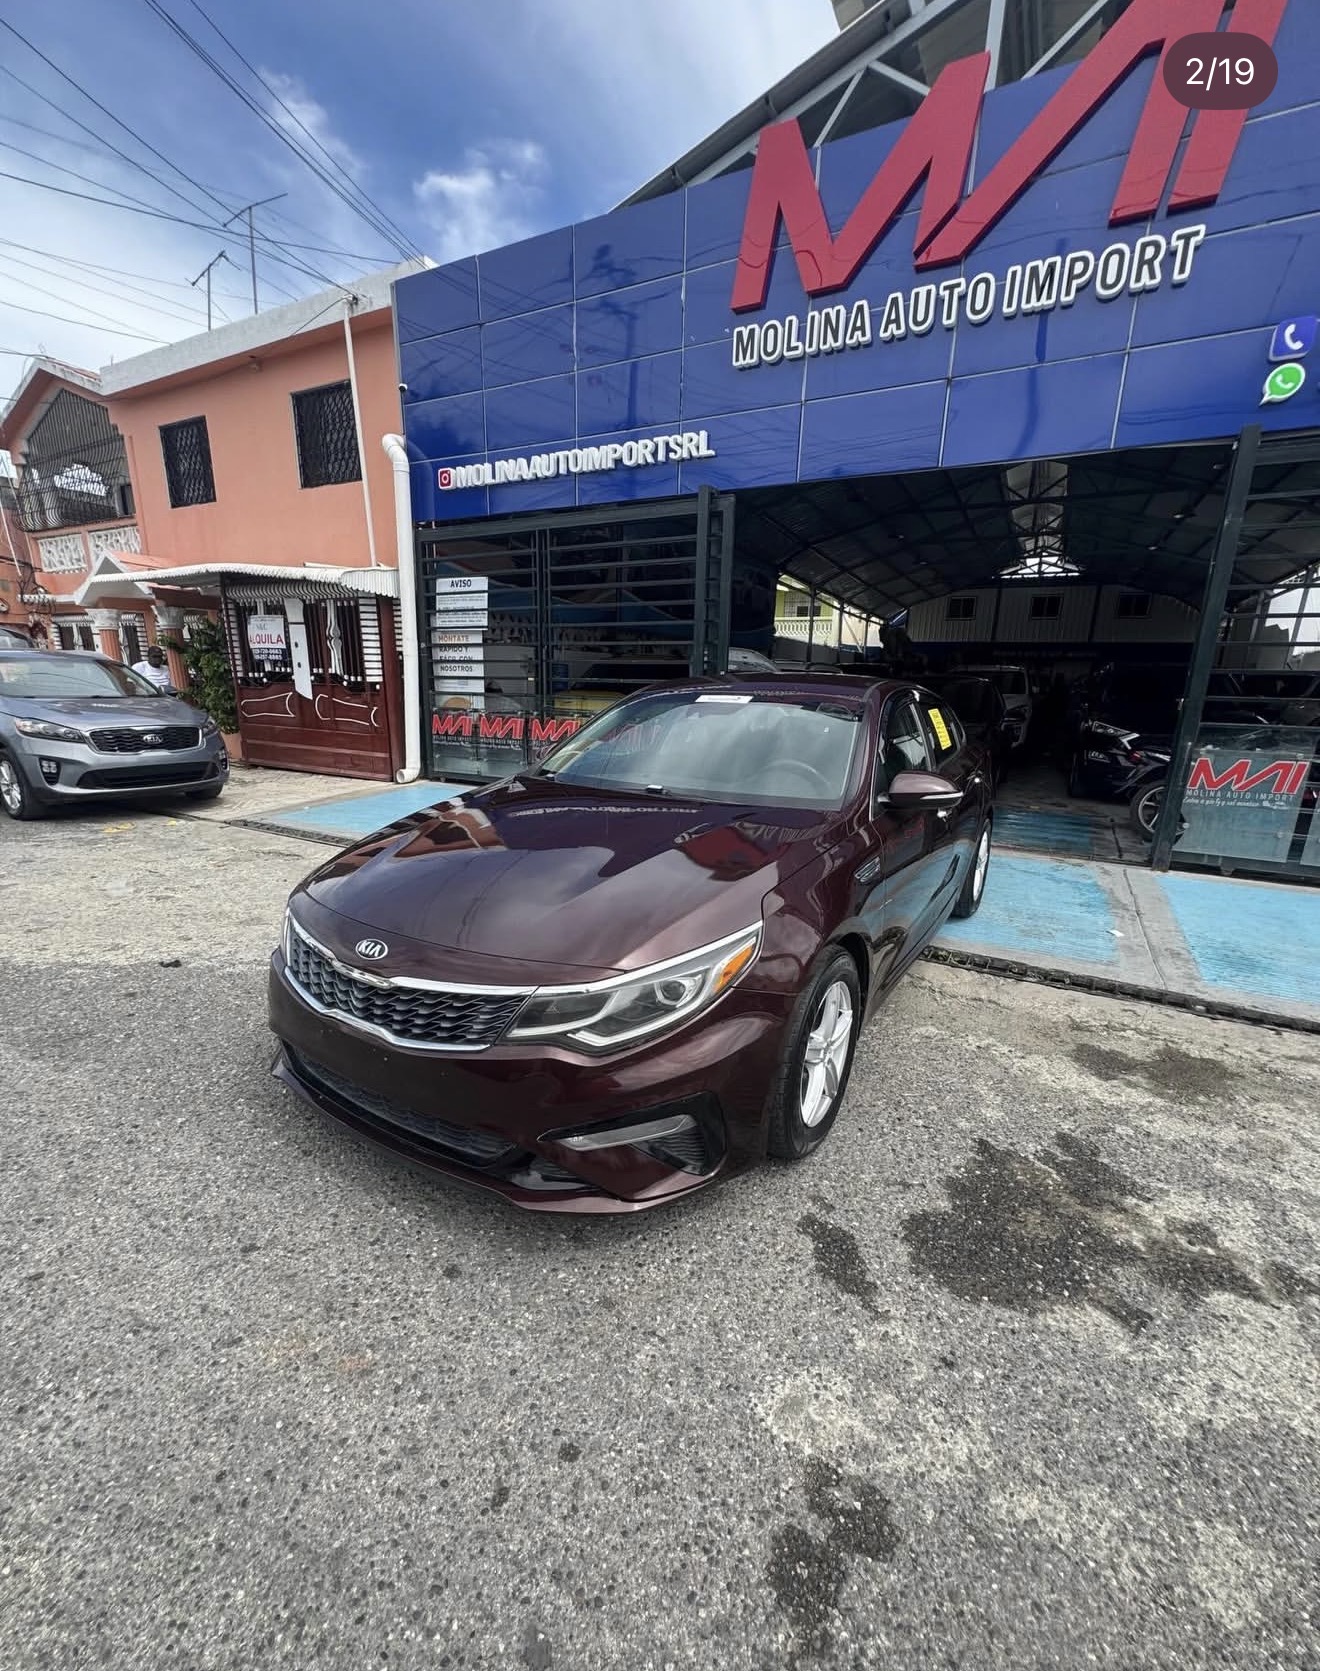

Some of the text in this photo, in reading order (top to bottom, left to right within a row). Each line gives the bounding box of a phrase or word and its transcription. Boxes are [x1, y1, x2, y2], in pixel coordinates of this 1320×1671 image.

[731, 225, 1207, 367] MOLINA AUTO IMPORT
[450, 579, 472, 588] AVISO
[1187, 758, 1310, 795] MAI
[1185, 789, 1295, 801] MOLINA AUTO IMPORT
[358, 940, 382, 957] KIA
